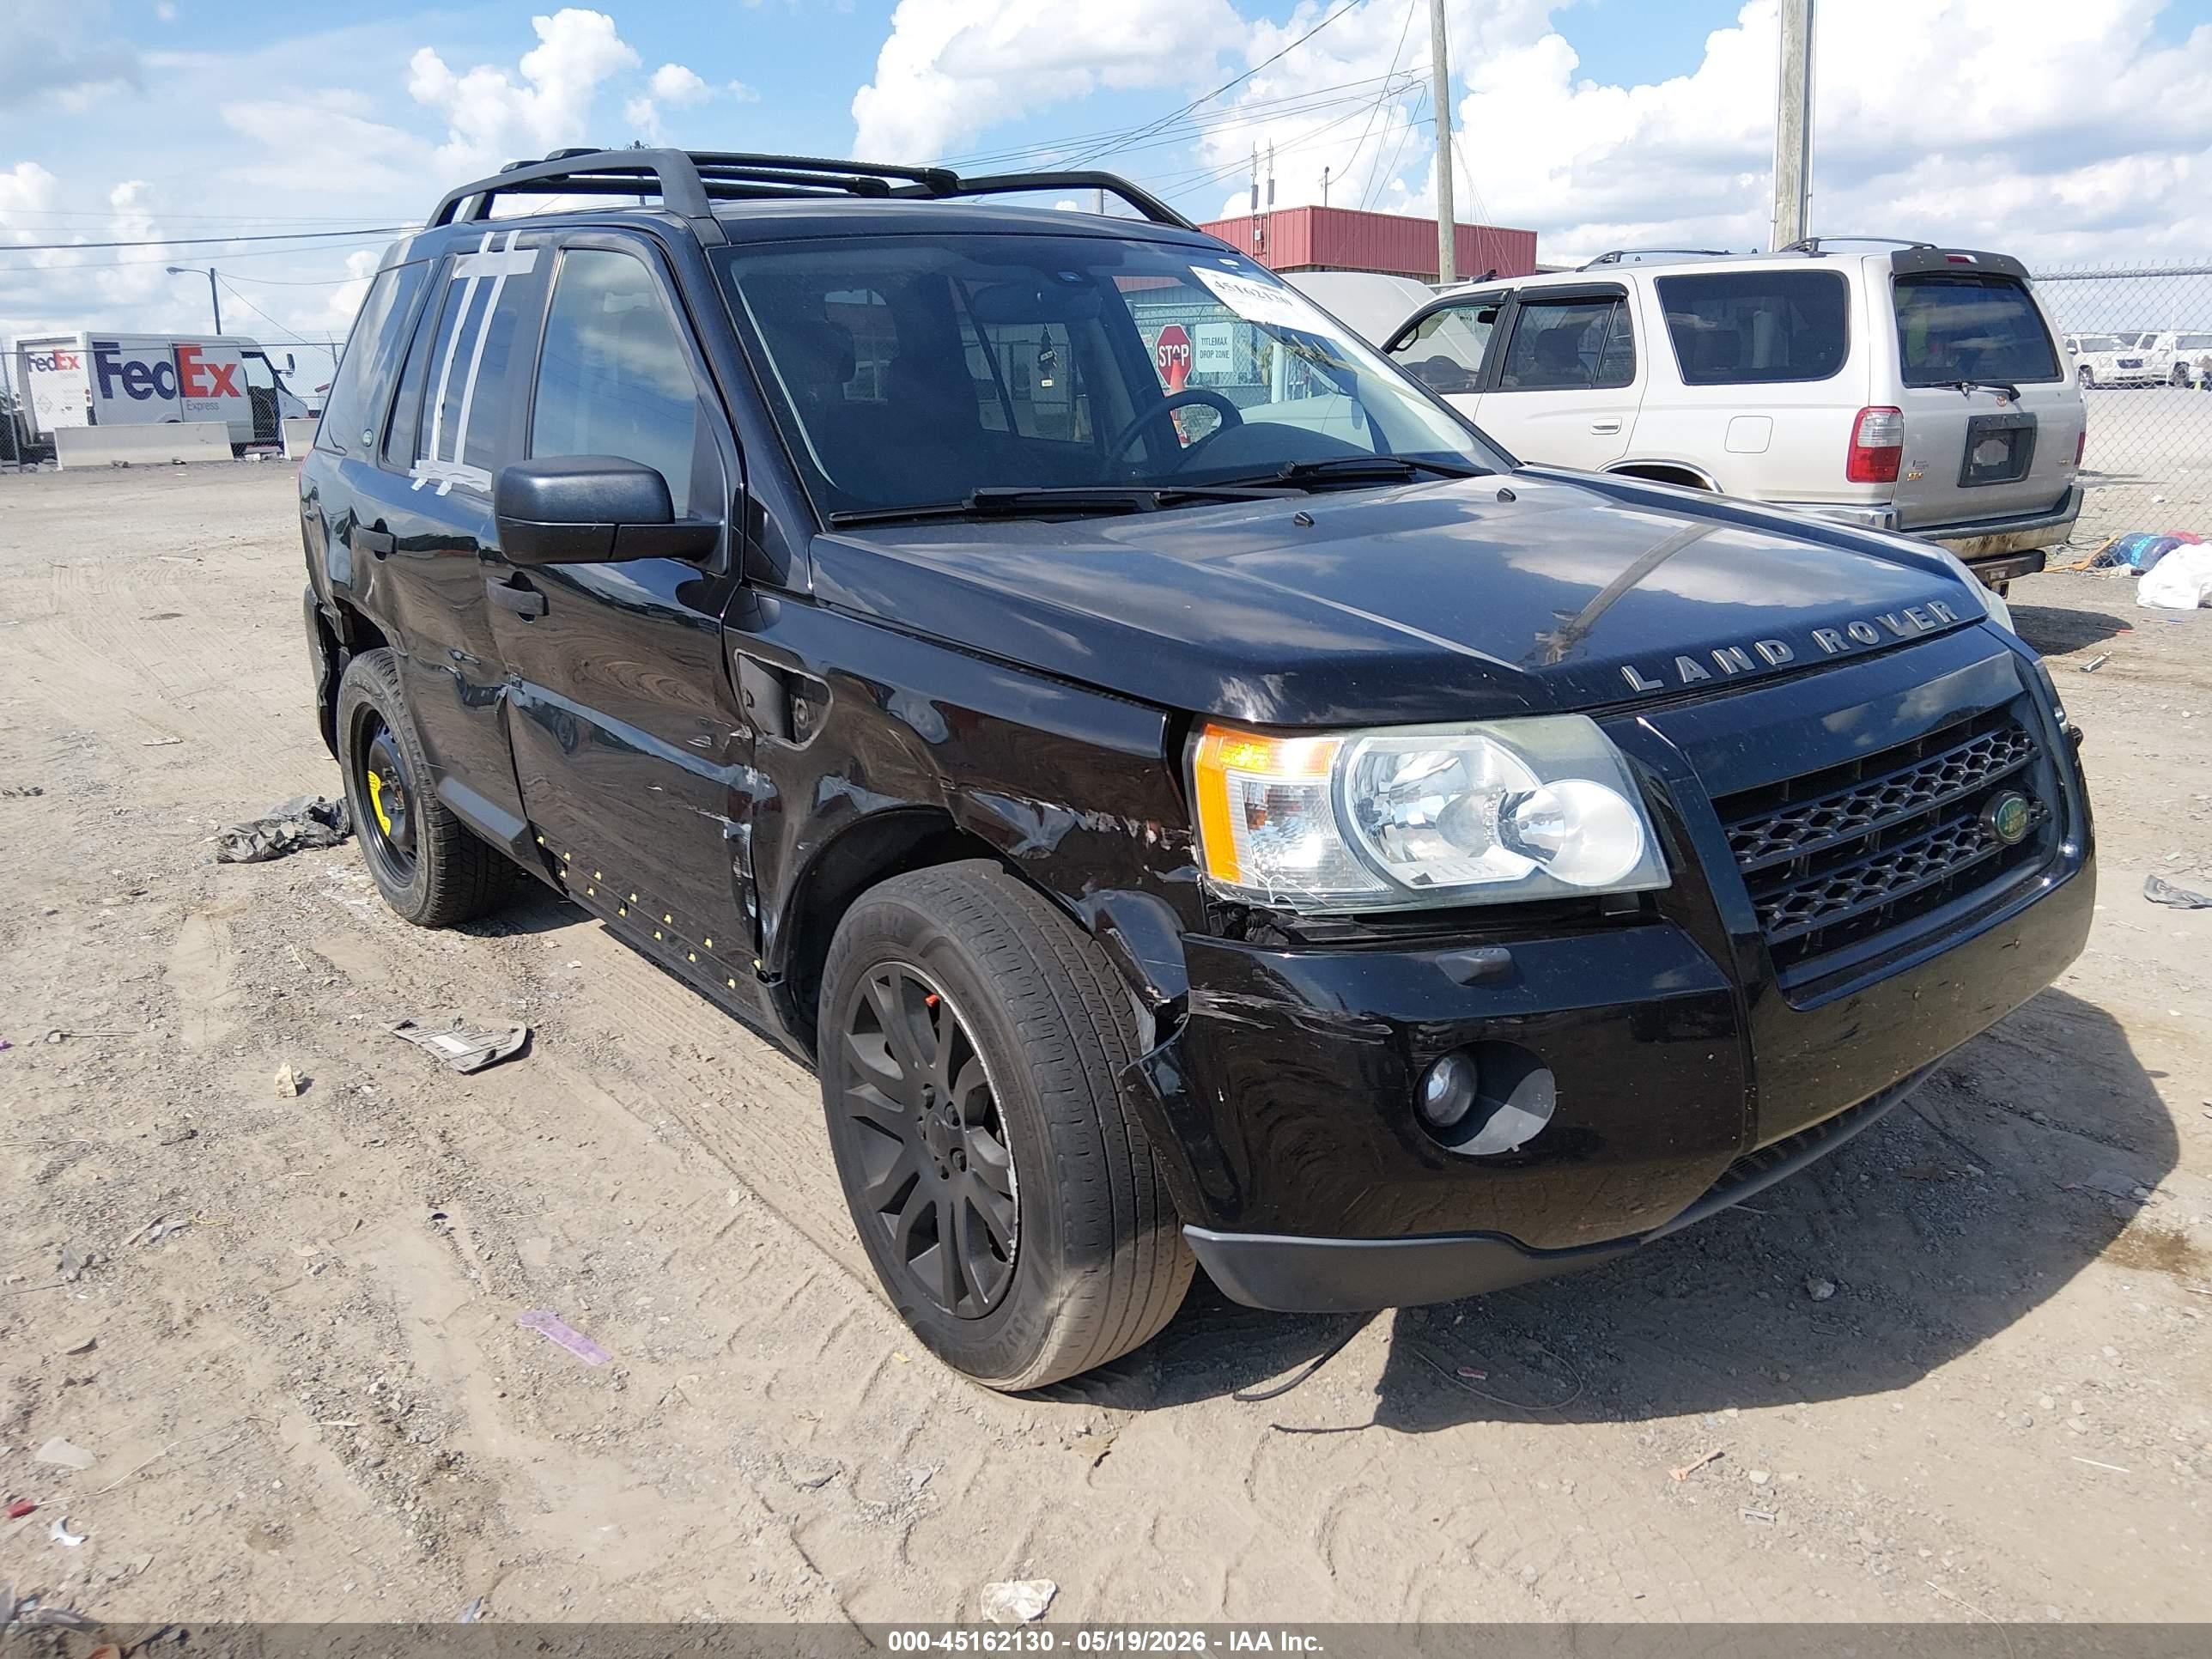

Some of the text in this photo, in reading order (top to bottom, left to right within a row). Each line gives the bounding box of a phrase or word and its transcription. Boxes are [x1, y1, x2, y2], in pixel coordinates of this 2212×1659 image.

[1201, 337, 1228, 346] TITLEMAX
[27, 349, 80, 372] FedEx
[1200, 349, 1230, 359] DROP ZONE
[92, 342, 241, 400] FedEx
[186, 399, 220, 411] Express
[1620, 600, 1959, 693] LAND ROVER
